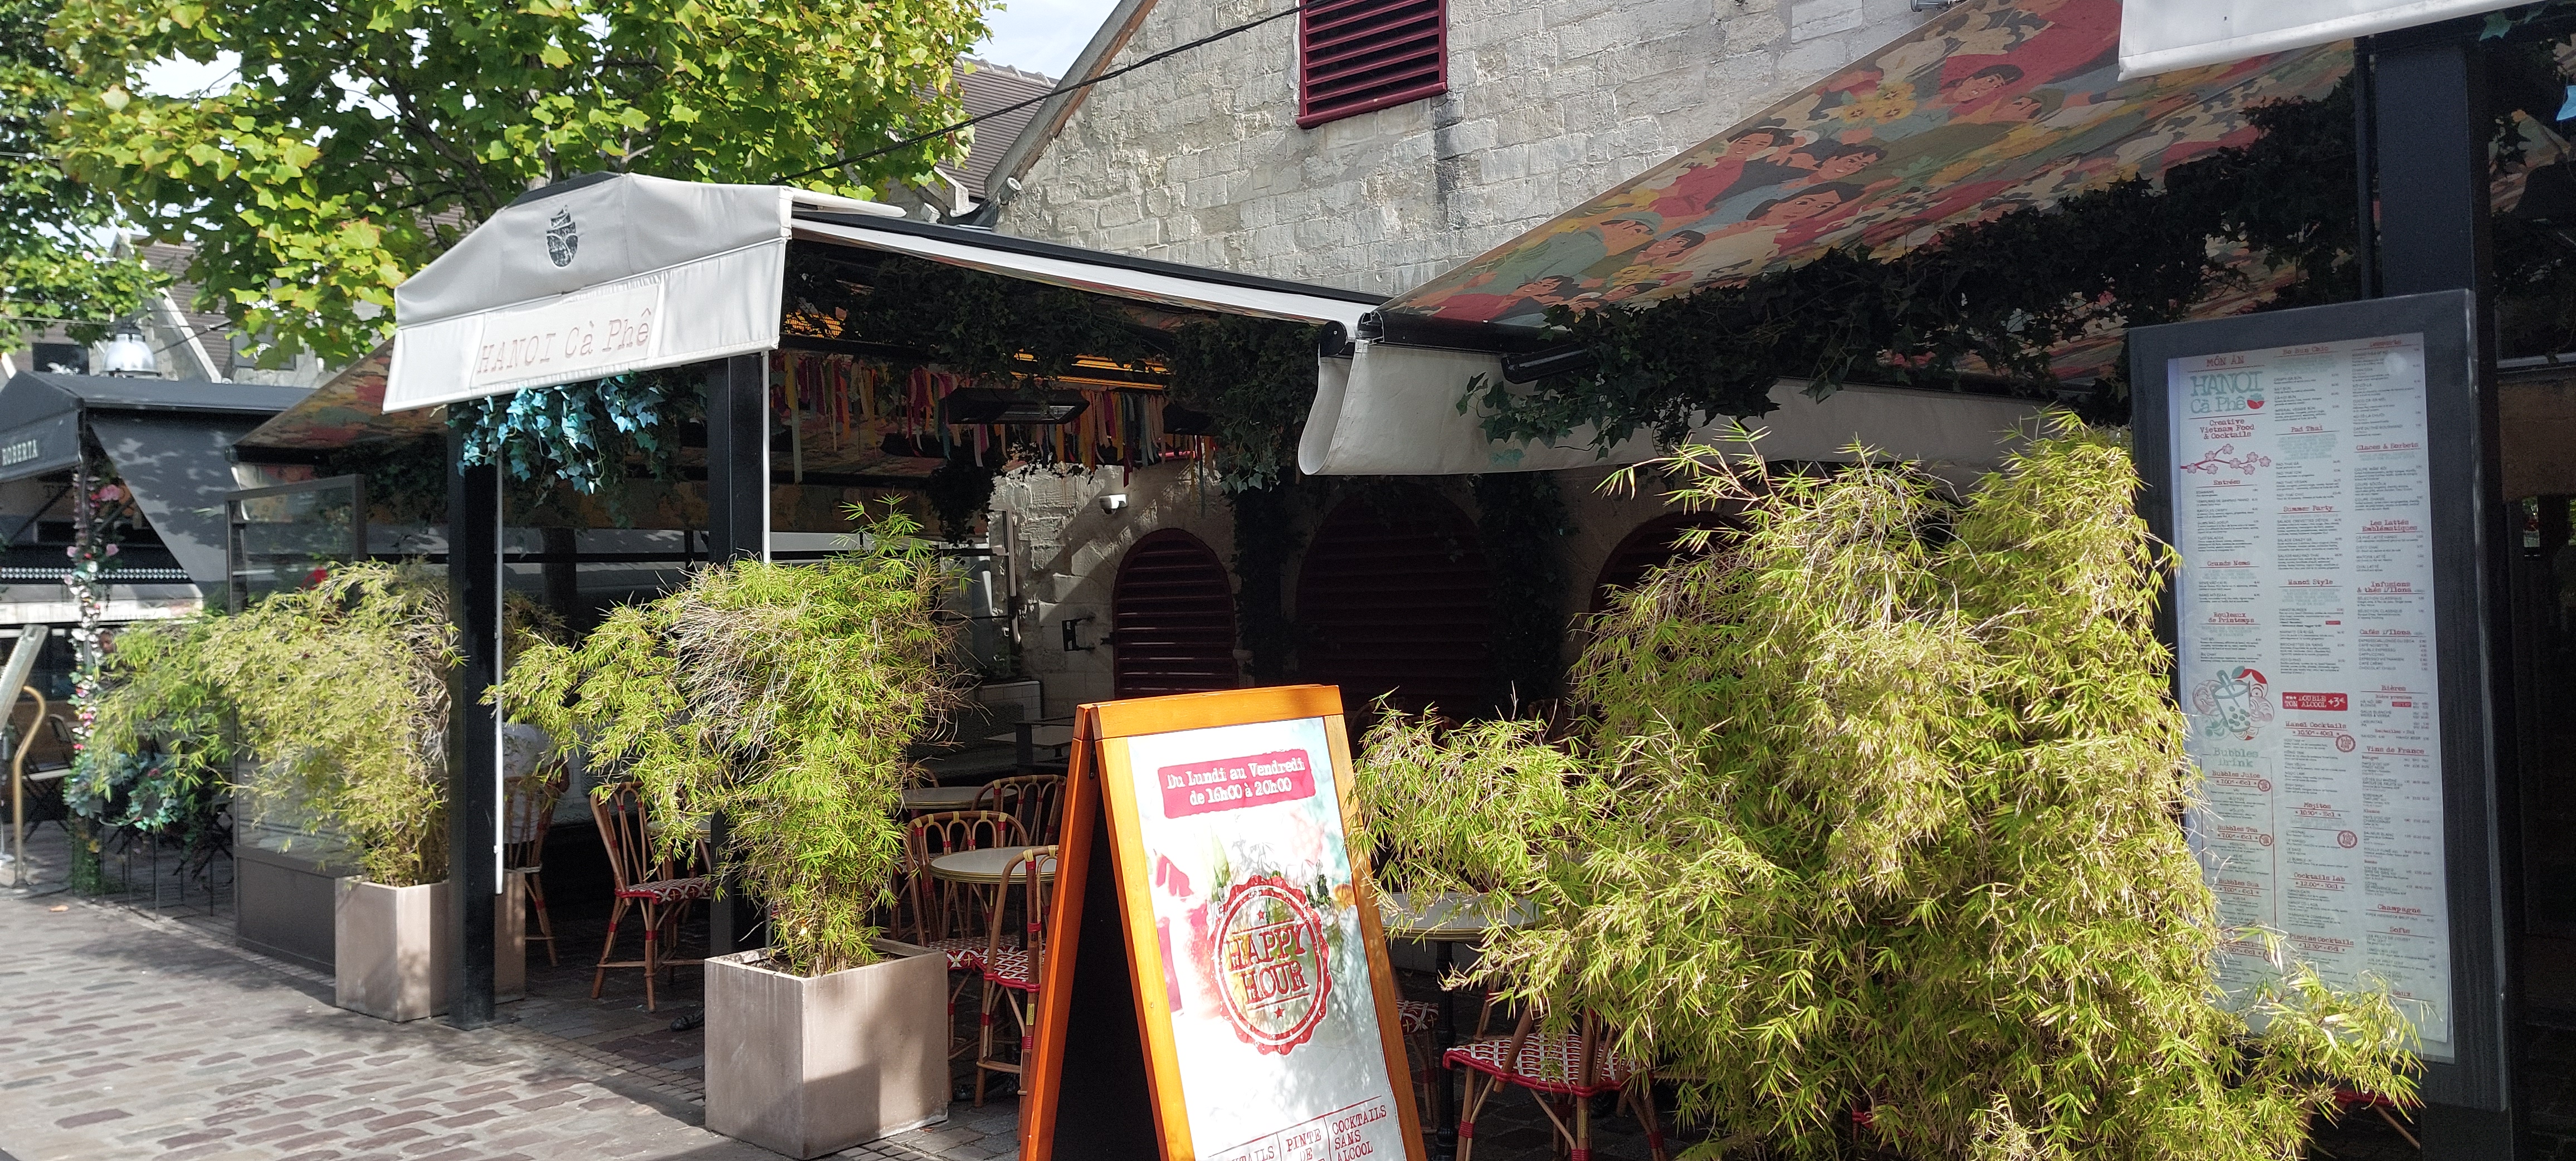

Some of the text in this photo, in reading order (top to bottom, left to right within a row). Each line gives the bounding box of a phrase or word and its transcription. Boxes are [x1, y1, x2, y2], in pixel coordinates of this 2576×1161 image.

[477, 307, 651, 373] HANOI Cà Phê
[2189, 371, 2263, 396] HANOI
[2215, 396, 2246, 412] Phê
[2, 439, 38, 466] ROBERTA
[2213, 748, 2258, 758] Bubbles
[2218, 758, 2253, 767] Drink
[1167, 758, 1305, 789] Du Lundi au Vendredi
[1190, 777, 1292, 806] de 16h00 à 20h00
[2378, 904, 2421, 914] Champagne
[1224, 923, 1306, 971] HAPPY
[2318, 936, 2354, 945] Cocktails
[1240, 960, 1309, 1004] HOUR
[1332, 1105, 1387, 1135] COCKTAILS
[1286, 1129, 1321, 1152] PINTE
[1334, 1130, 1362, 1150] SANS
[1338, 1142, 1373, 1161] ALCOOL
[1300, 1148, 1313, 1161] DE
